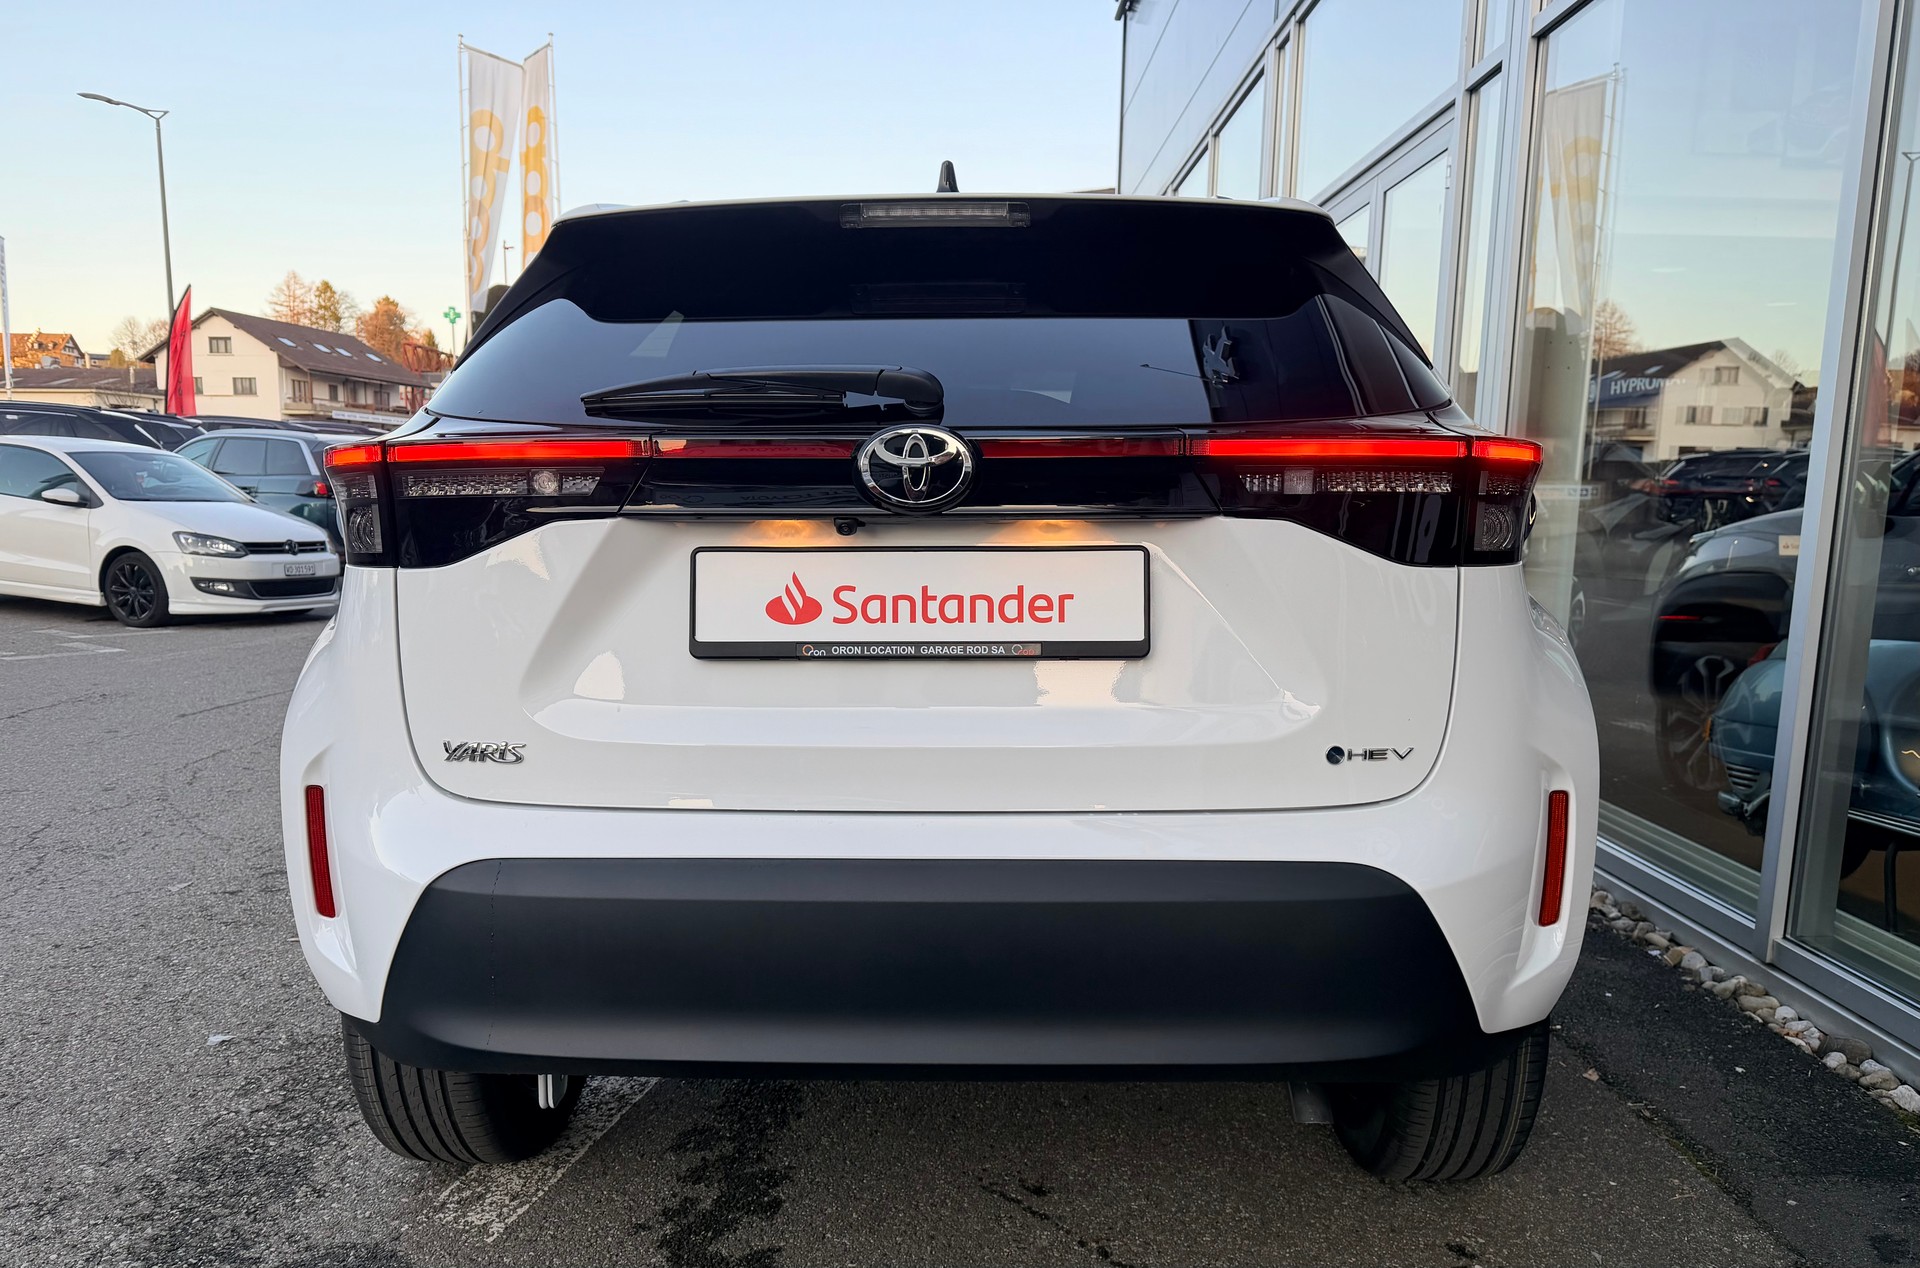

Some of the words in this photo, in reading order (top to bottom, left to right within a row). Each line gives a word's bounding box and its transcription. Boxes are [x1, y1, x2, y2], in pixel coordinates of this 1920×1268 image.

[832, 584, 1075, 625] Santander
[831, 645, 861, 655] ORON
[864, 645, 915, 655] LOCATION
[920, 645, 964, 655] GARAGE
[966, 645, 989, 655] ROD
[991, 645, 1006, 655] SA
[1346, 747, 1414, 761] HEV
